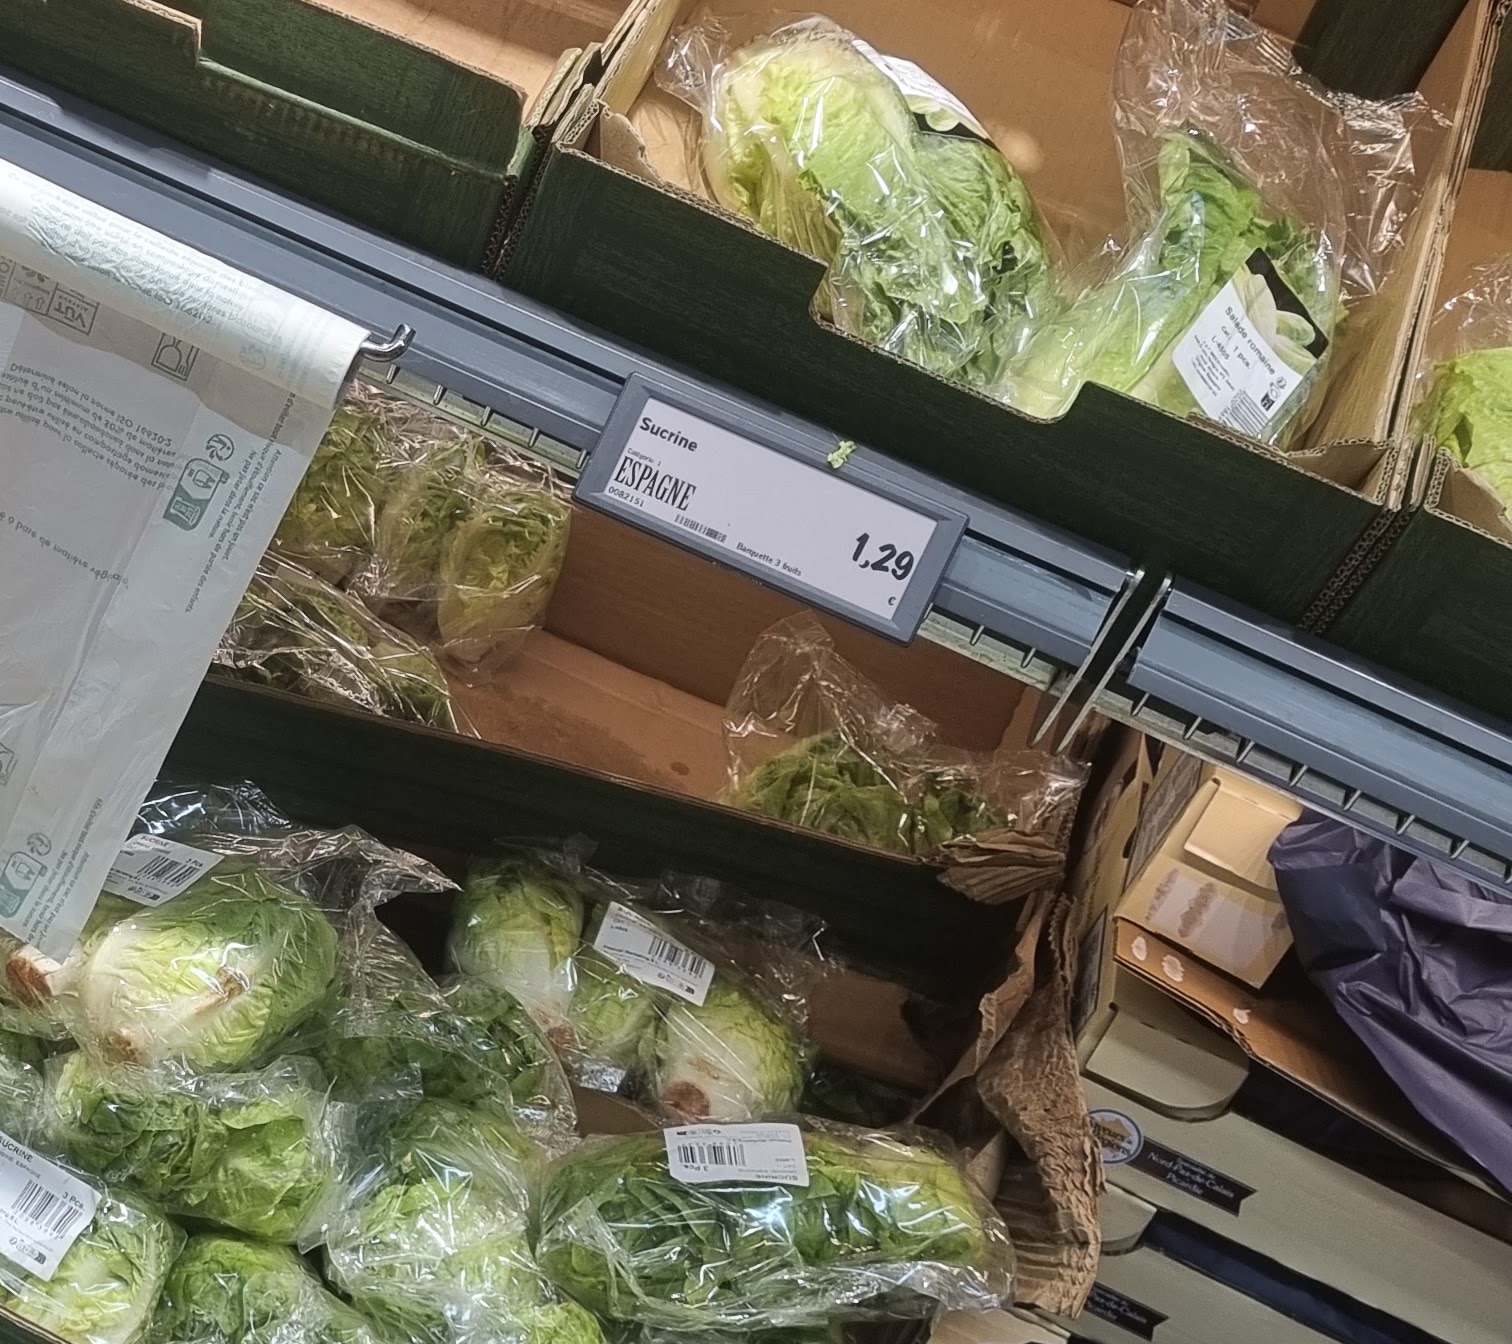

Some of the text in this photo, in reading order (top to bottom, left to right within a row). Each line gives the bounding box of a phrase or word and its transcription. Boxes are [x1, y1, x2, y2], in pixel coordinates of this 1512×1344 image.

[1222, 306, 1276, 375] Salade romaine
[637, 416, 700, 453] Sucrine
[247, 449, 257, 460] Ne
[257, 437, 274, 461] risque
[239, 458, 251, 473] pas
[260, 448, 281, 483] Attention
[231, 471, 246, 491] jeter
[256, 482, 264, 491] ce
[613, 454, 697, 512] ESPAGNE
[223, 489, 237, 508] dans
[250, 490, 260, 503] sac
[220, 507, 229, 516] la
[241, 502, 254, 520] n'est
[234, 518, 246, 531] pas
[213, 543, 222, 553] de
[735, 541, 774, 565] Barquette
[774, 558, 781, 567] 3
[846, 530, 917, 585] 1,29
[196, 574, 207, 587] des
[62, 1191, 69, 1199] 3
